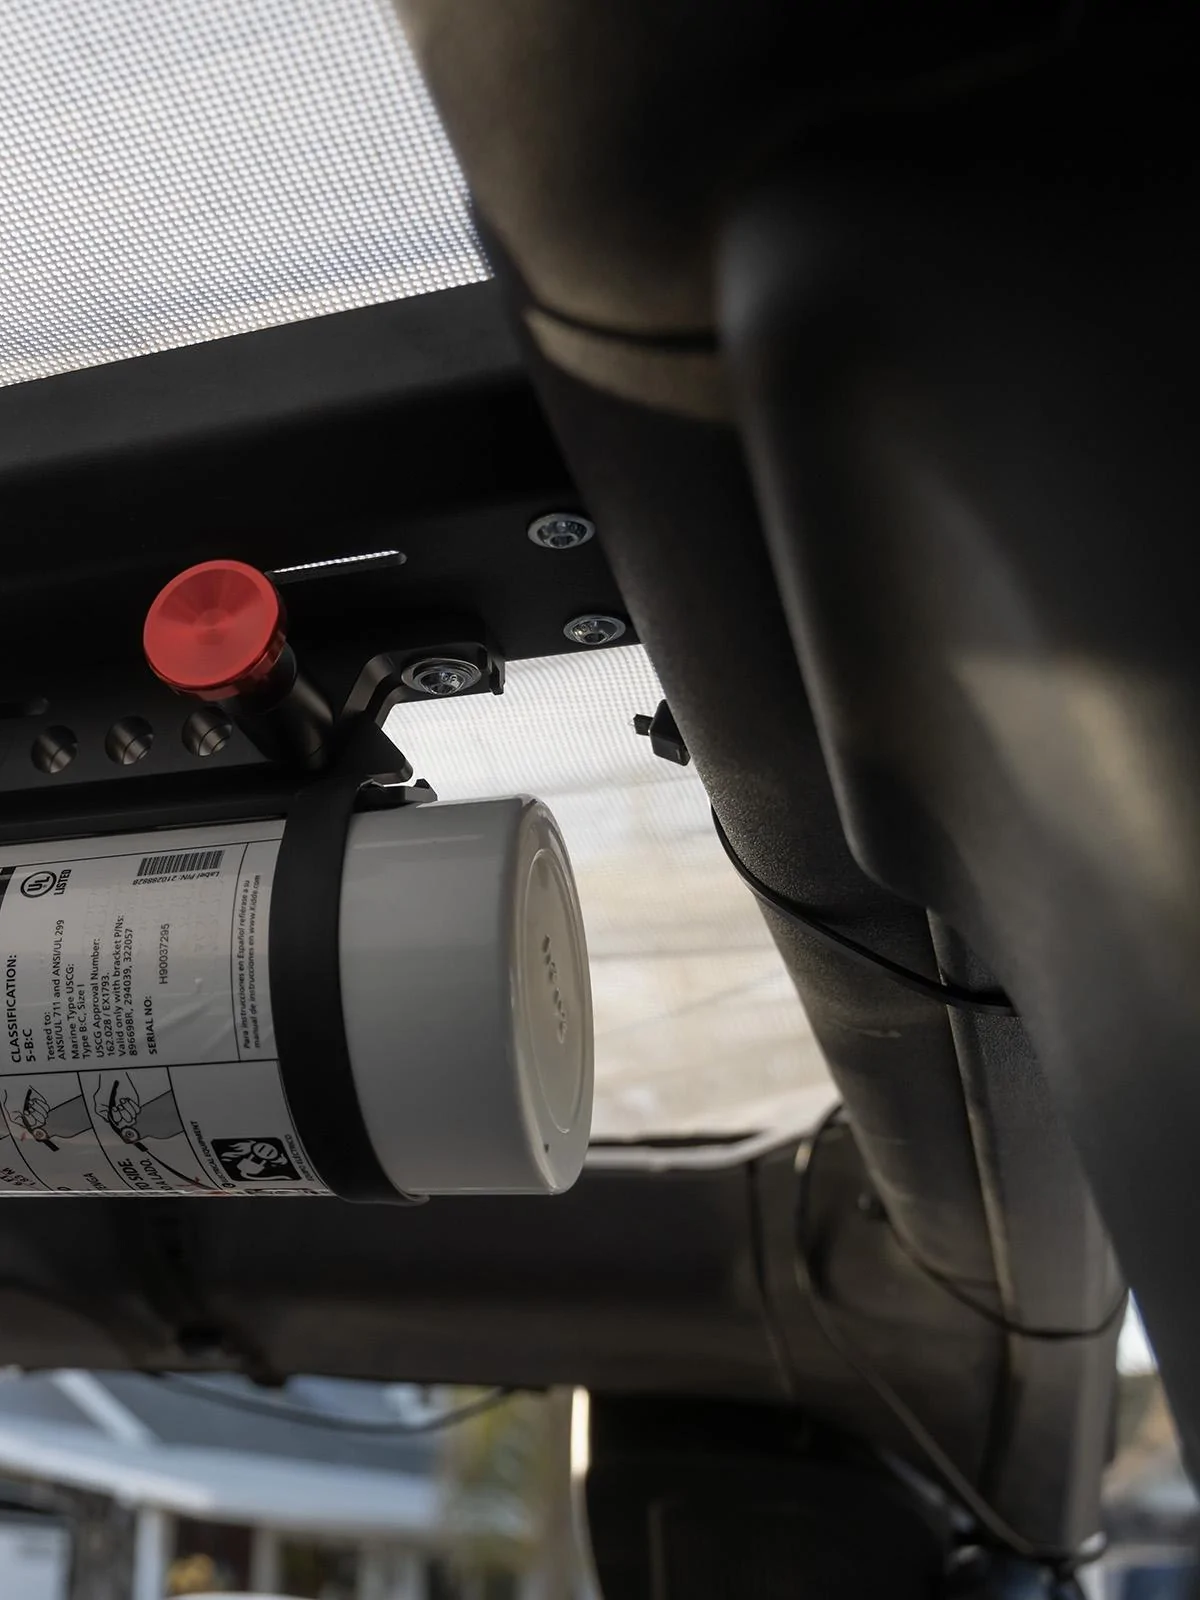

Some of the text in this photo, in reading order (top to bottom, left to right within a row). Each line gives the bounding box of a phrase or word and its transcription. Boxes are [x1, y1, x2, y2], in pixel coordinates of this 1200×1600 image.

[54, 869, 72, 896] LISTED
[243, 880, 250, 888] su
[158, 923, 171, 984] H90037295
[237, 928, 246, 959] Español
[247, 874, 261, 1048] manual de instrucciones en www.Kidde.com
[238, 961, 245, 971] en
[52, 920, 66, 1060] ANSI/UL 711 and ANSI/UL 299
[77, 990, 86, 1010] Size
[90, 938, 105, 1058] USCG Approval Number:
[101, 972, 111, 1010] EX1793.
[112, 915, 127, 1057] Valid only with bracket P/Ns:
[123, 928, 138, 1056] 896698R, 294039, 322057
[238, 974, 249, 1028] instrucciones
[6, 954, 21, 1063] CLASSIFICATION:
[65, 964, 80, 1059] Marine Type USCG:
[143, 995, 158, 1055] SERIAL NO:
[22, 1029, 36, 1062] 5-B:C
[42, 1012, 55, 1060] Tested to:
[81, 1035, 92, 1058] Type
[102, 1019, 115, 1057] 162.028
[242, 1031, 252, 1049] Para
[117, 1158, 144, 1181] SIDE.
[140, 1158, 161, 1180] LADO.
